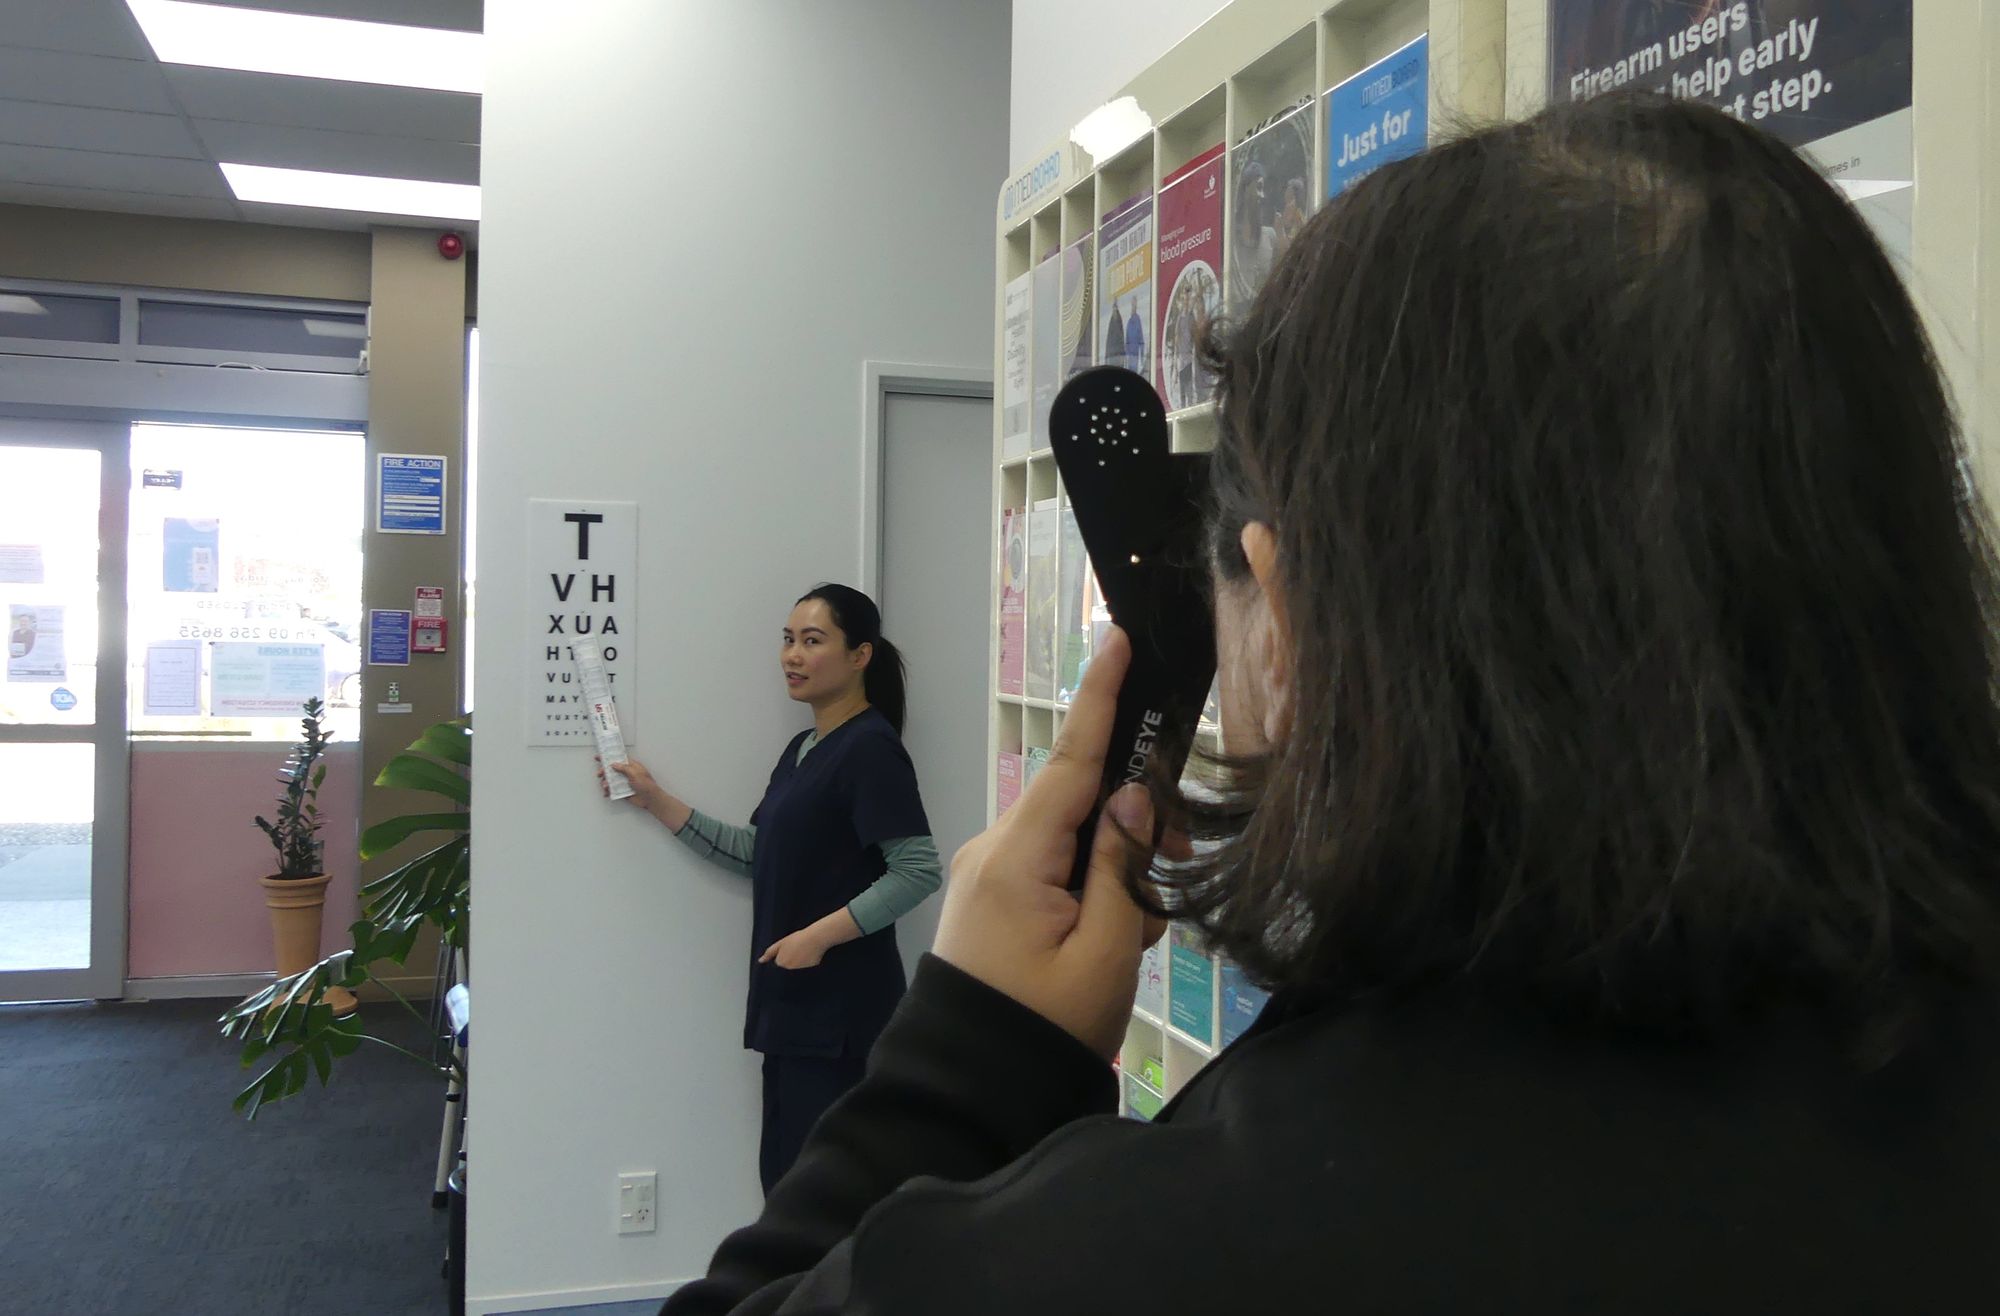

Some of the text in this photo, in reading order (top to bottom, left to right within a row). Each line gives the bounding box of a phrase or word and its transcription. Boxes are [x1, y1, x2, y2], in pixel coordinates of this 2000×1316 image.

[1570, 2, 1747, 102] Firearm users
[1672, 16, 1819, 100] help early
[1752, 69, 1833, 120] step.
[1337, 108, 1411, 168] Just for
[1160, 228, 1211, 263] blood pressure
[384, 458, 441, 468] FIRE ACTION
[564, 513, 603, 560] T
[418, 620, 441, 628] FIRE
[1123, 709, 1162, 783] NDEYE
